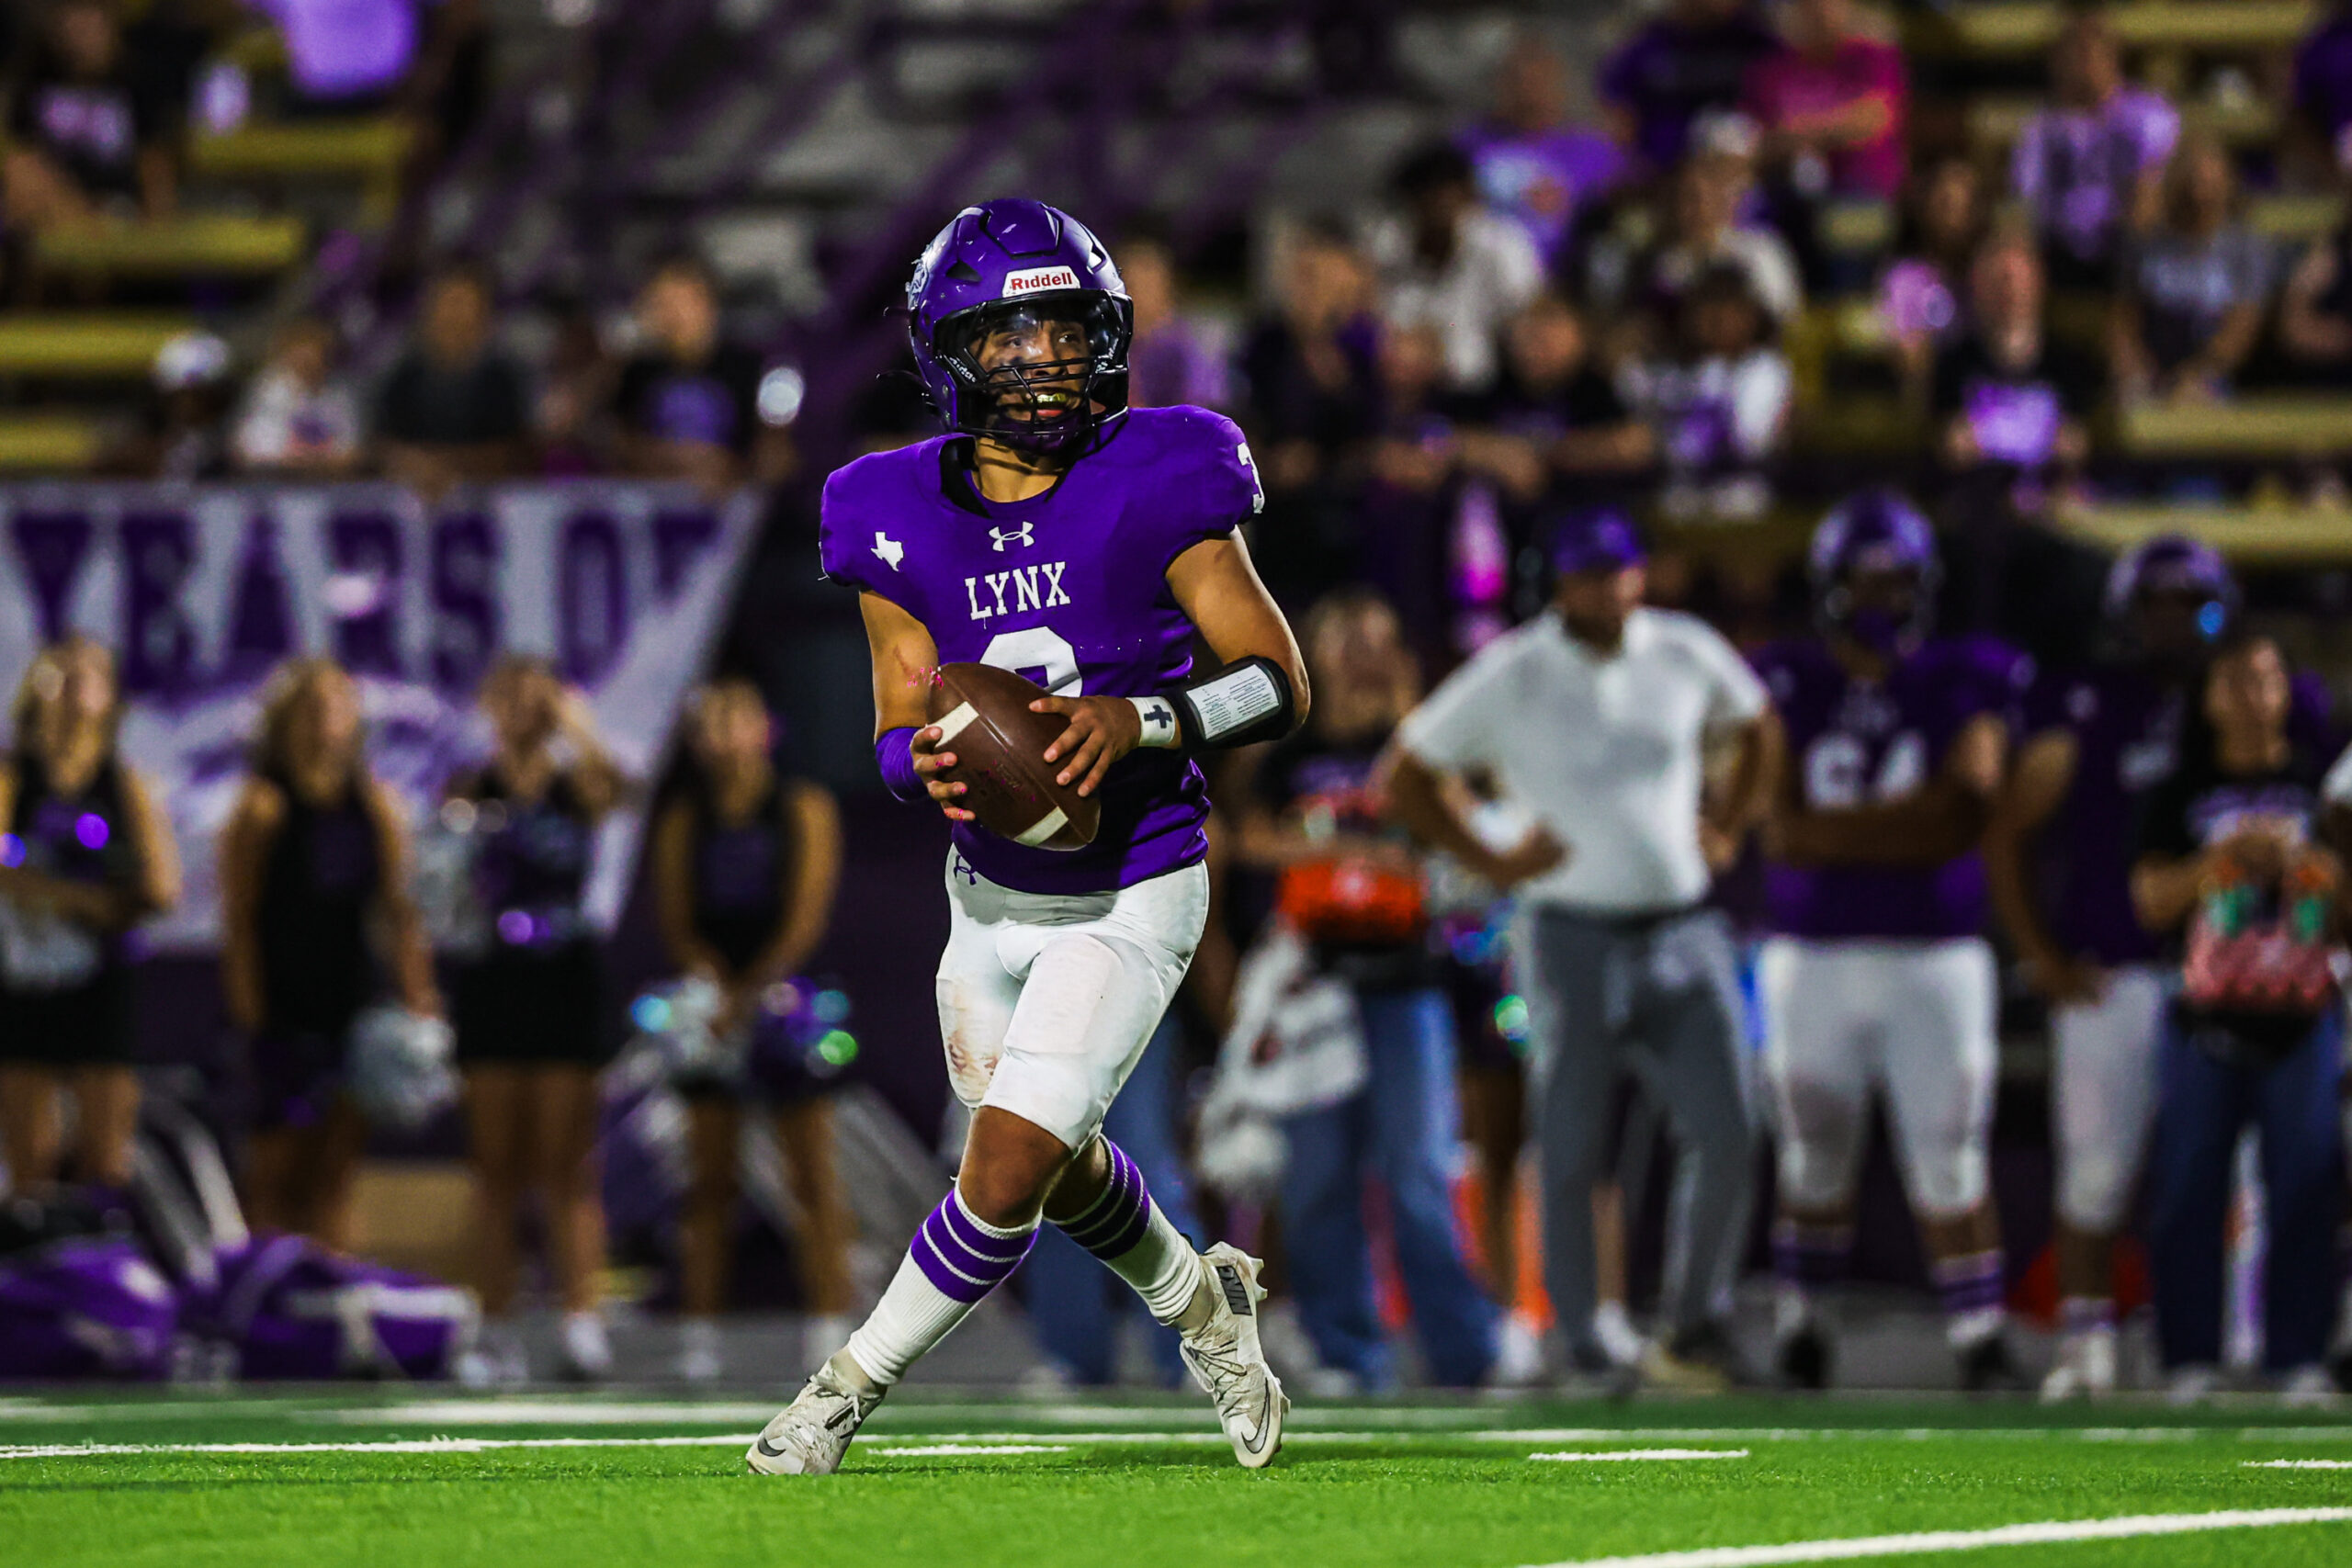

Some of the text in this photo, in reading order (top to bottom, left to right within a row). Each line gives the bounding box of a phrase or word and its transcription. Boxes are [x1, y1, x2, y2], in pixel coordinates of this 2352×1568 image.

[1011, 272, 1073, 290] Riddell
[11, 511, 502, 691] YEARS
[965, 561, 1071, 621] LYNX
